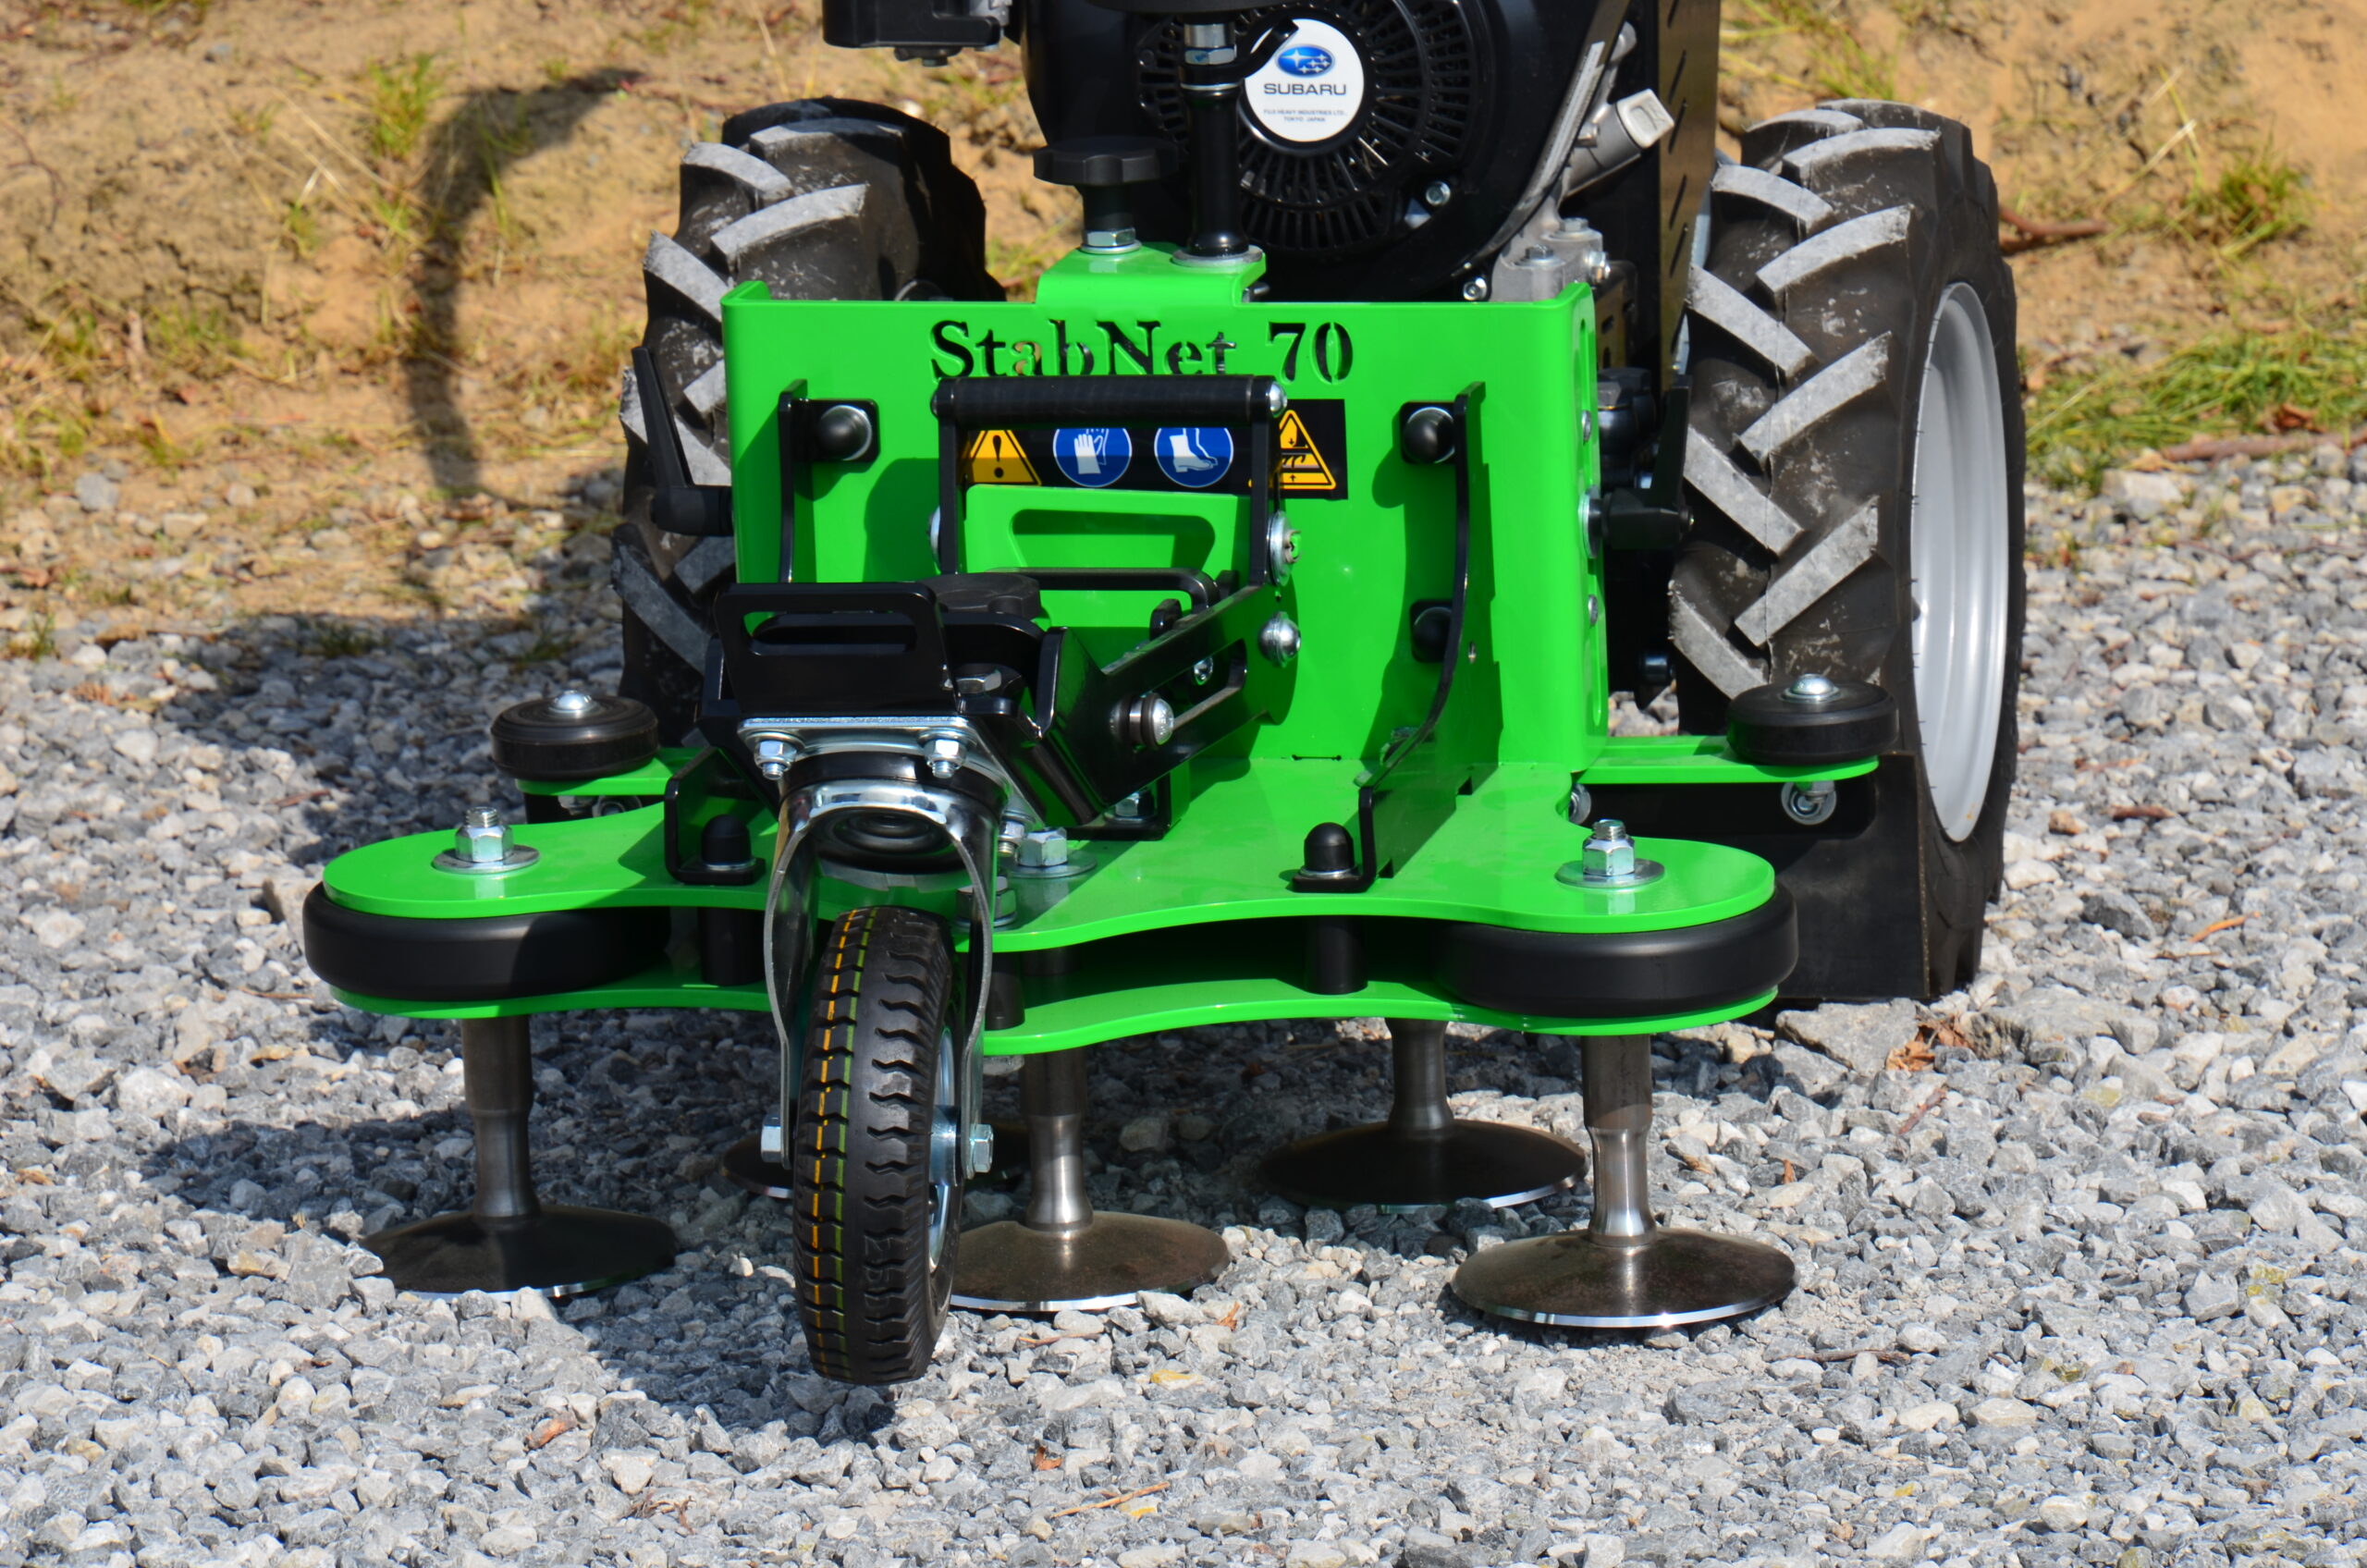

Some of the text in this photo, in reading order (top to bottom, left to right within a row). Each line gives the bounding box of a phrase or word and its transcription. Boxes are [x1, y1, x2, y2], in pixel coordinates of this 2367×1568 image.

[1263, 83, 1346, 95] SUBARU
[929, 319, 1354, 385] StabNet 70
